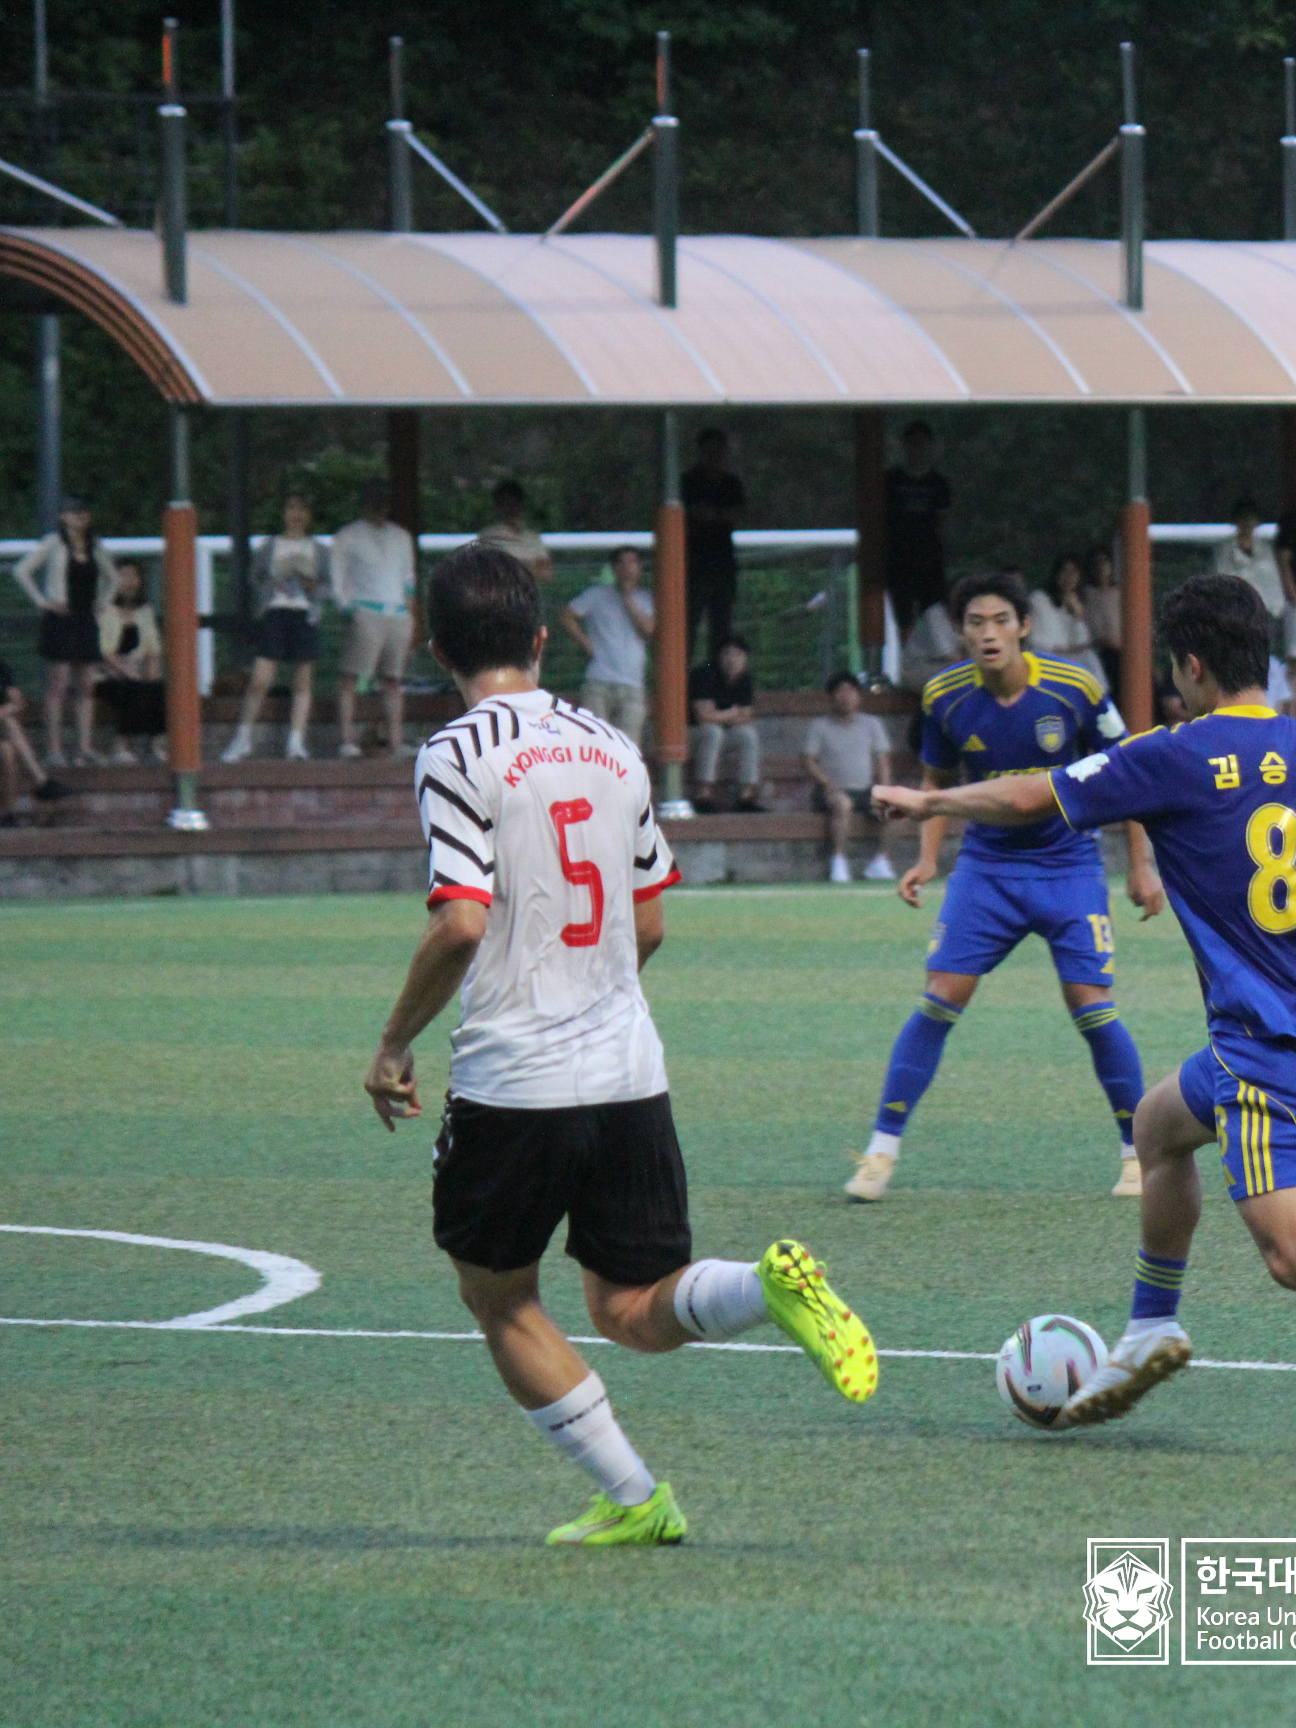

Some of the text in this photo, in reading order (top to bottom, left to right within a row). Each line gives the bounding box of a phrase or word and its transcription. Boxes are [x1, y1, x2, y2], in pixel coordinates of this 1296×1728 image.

[503, 745, 628, 788] KYONGGI UNIV.
[549, 797, 605, 947] 5
